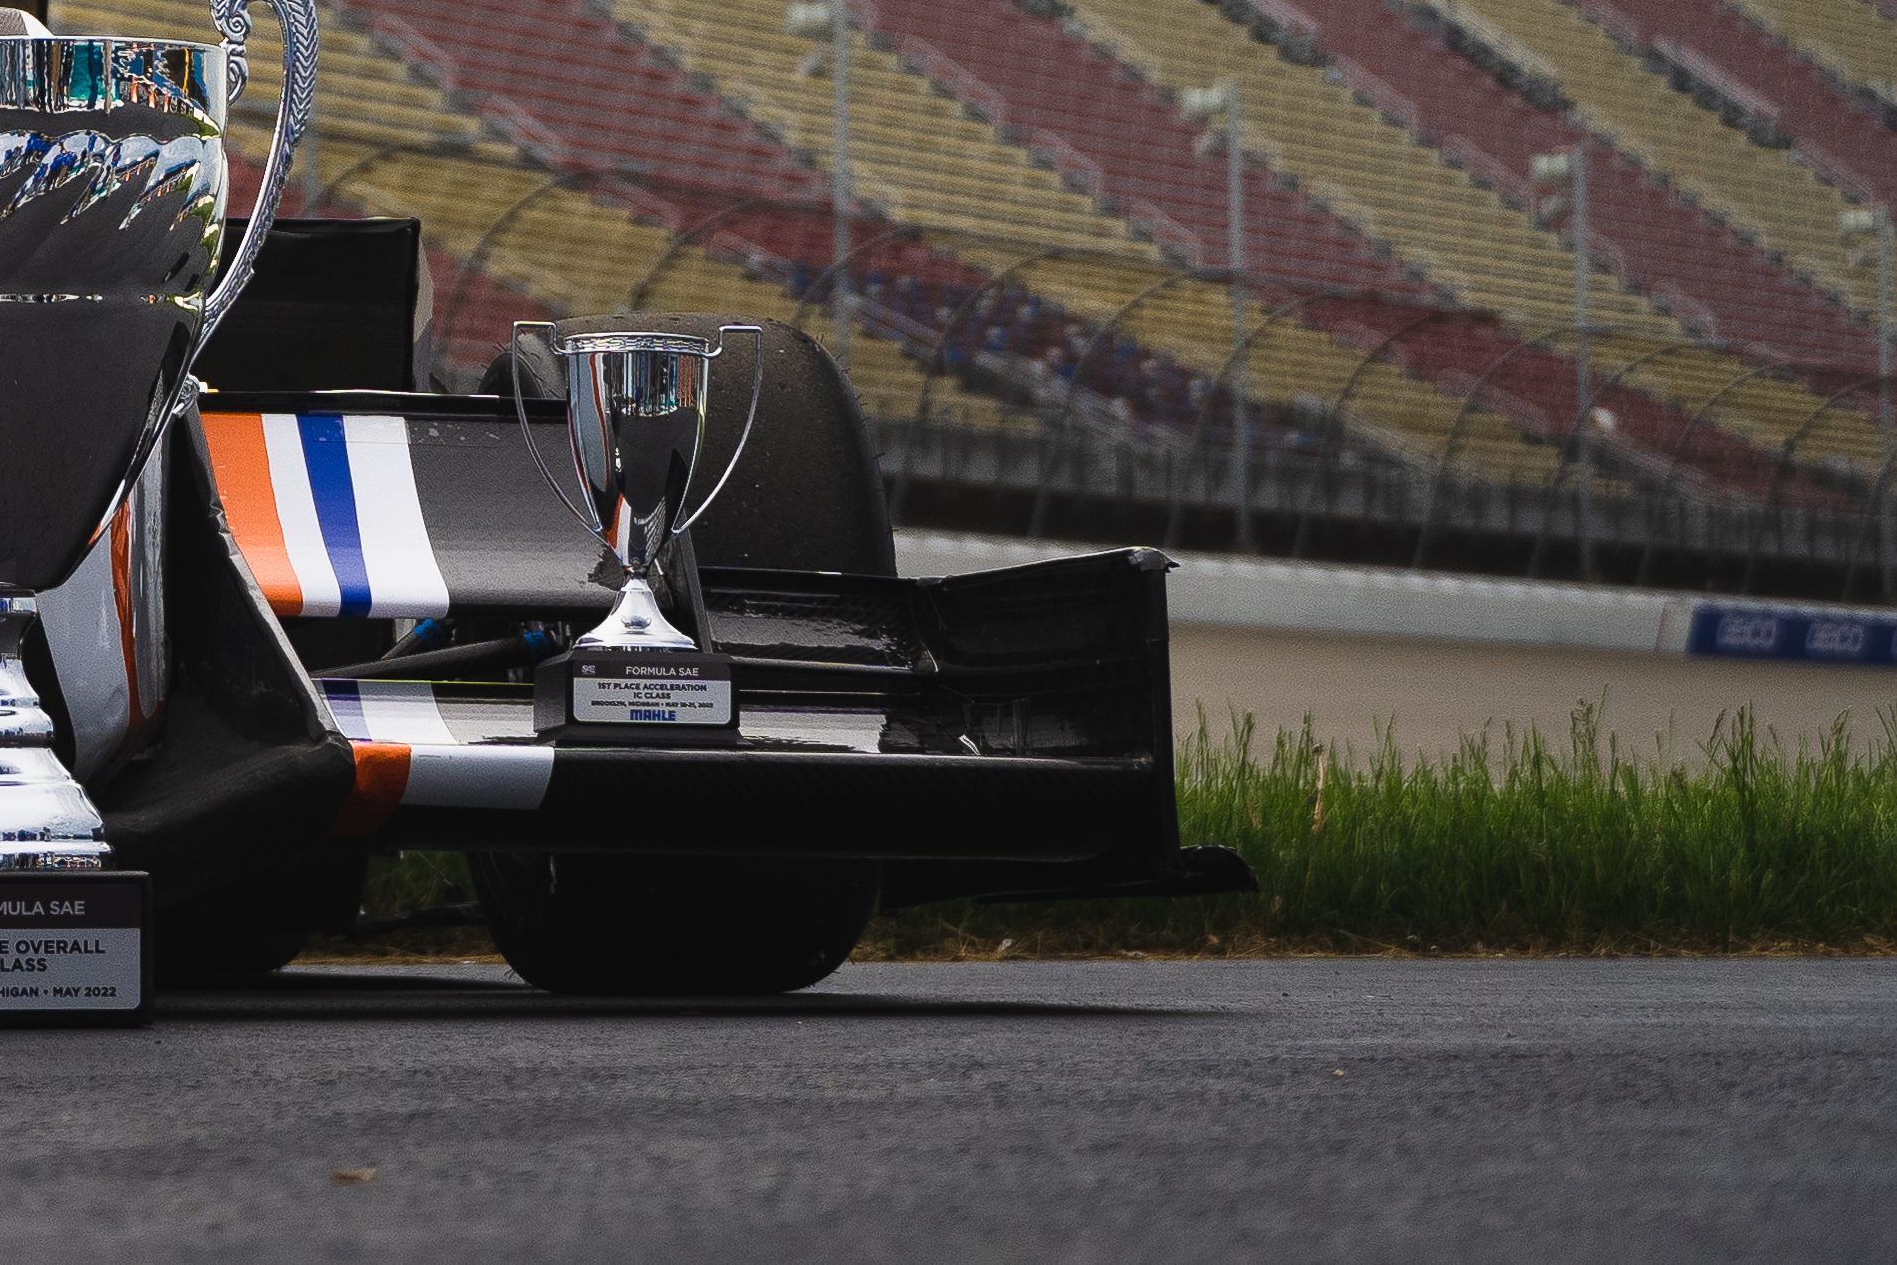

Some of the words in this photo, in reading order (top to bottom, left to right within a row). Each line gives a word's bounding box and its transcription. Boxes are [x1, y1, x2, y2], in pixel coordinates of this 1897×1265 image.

[625, 666, 676, 676] FORMULA
[678, 667, 699, 677] SAE
[597, 681, 612, 690] 1ST
[613, 682, 641, 691] PLACE
[642, 682, 708, 692] ACCELERATION
[633, 691, 643, 699] IC
[644, 692, 672, 700] CLASS
[629, 709, 677, 722] MAHLE
[49, 900, 86, 915] SAE
[15, 938, 106, 955] OVERALL
[52, 985, 82, 998] MAY
[83, 985, 118, 998] 2022
